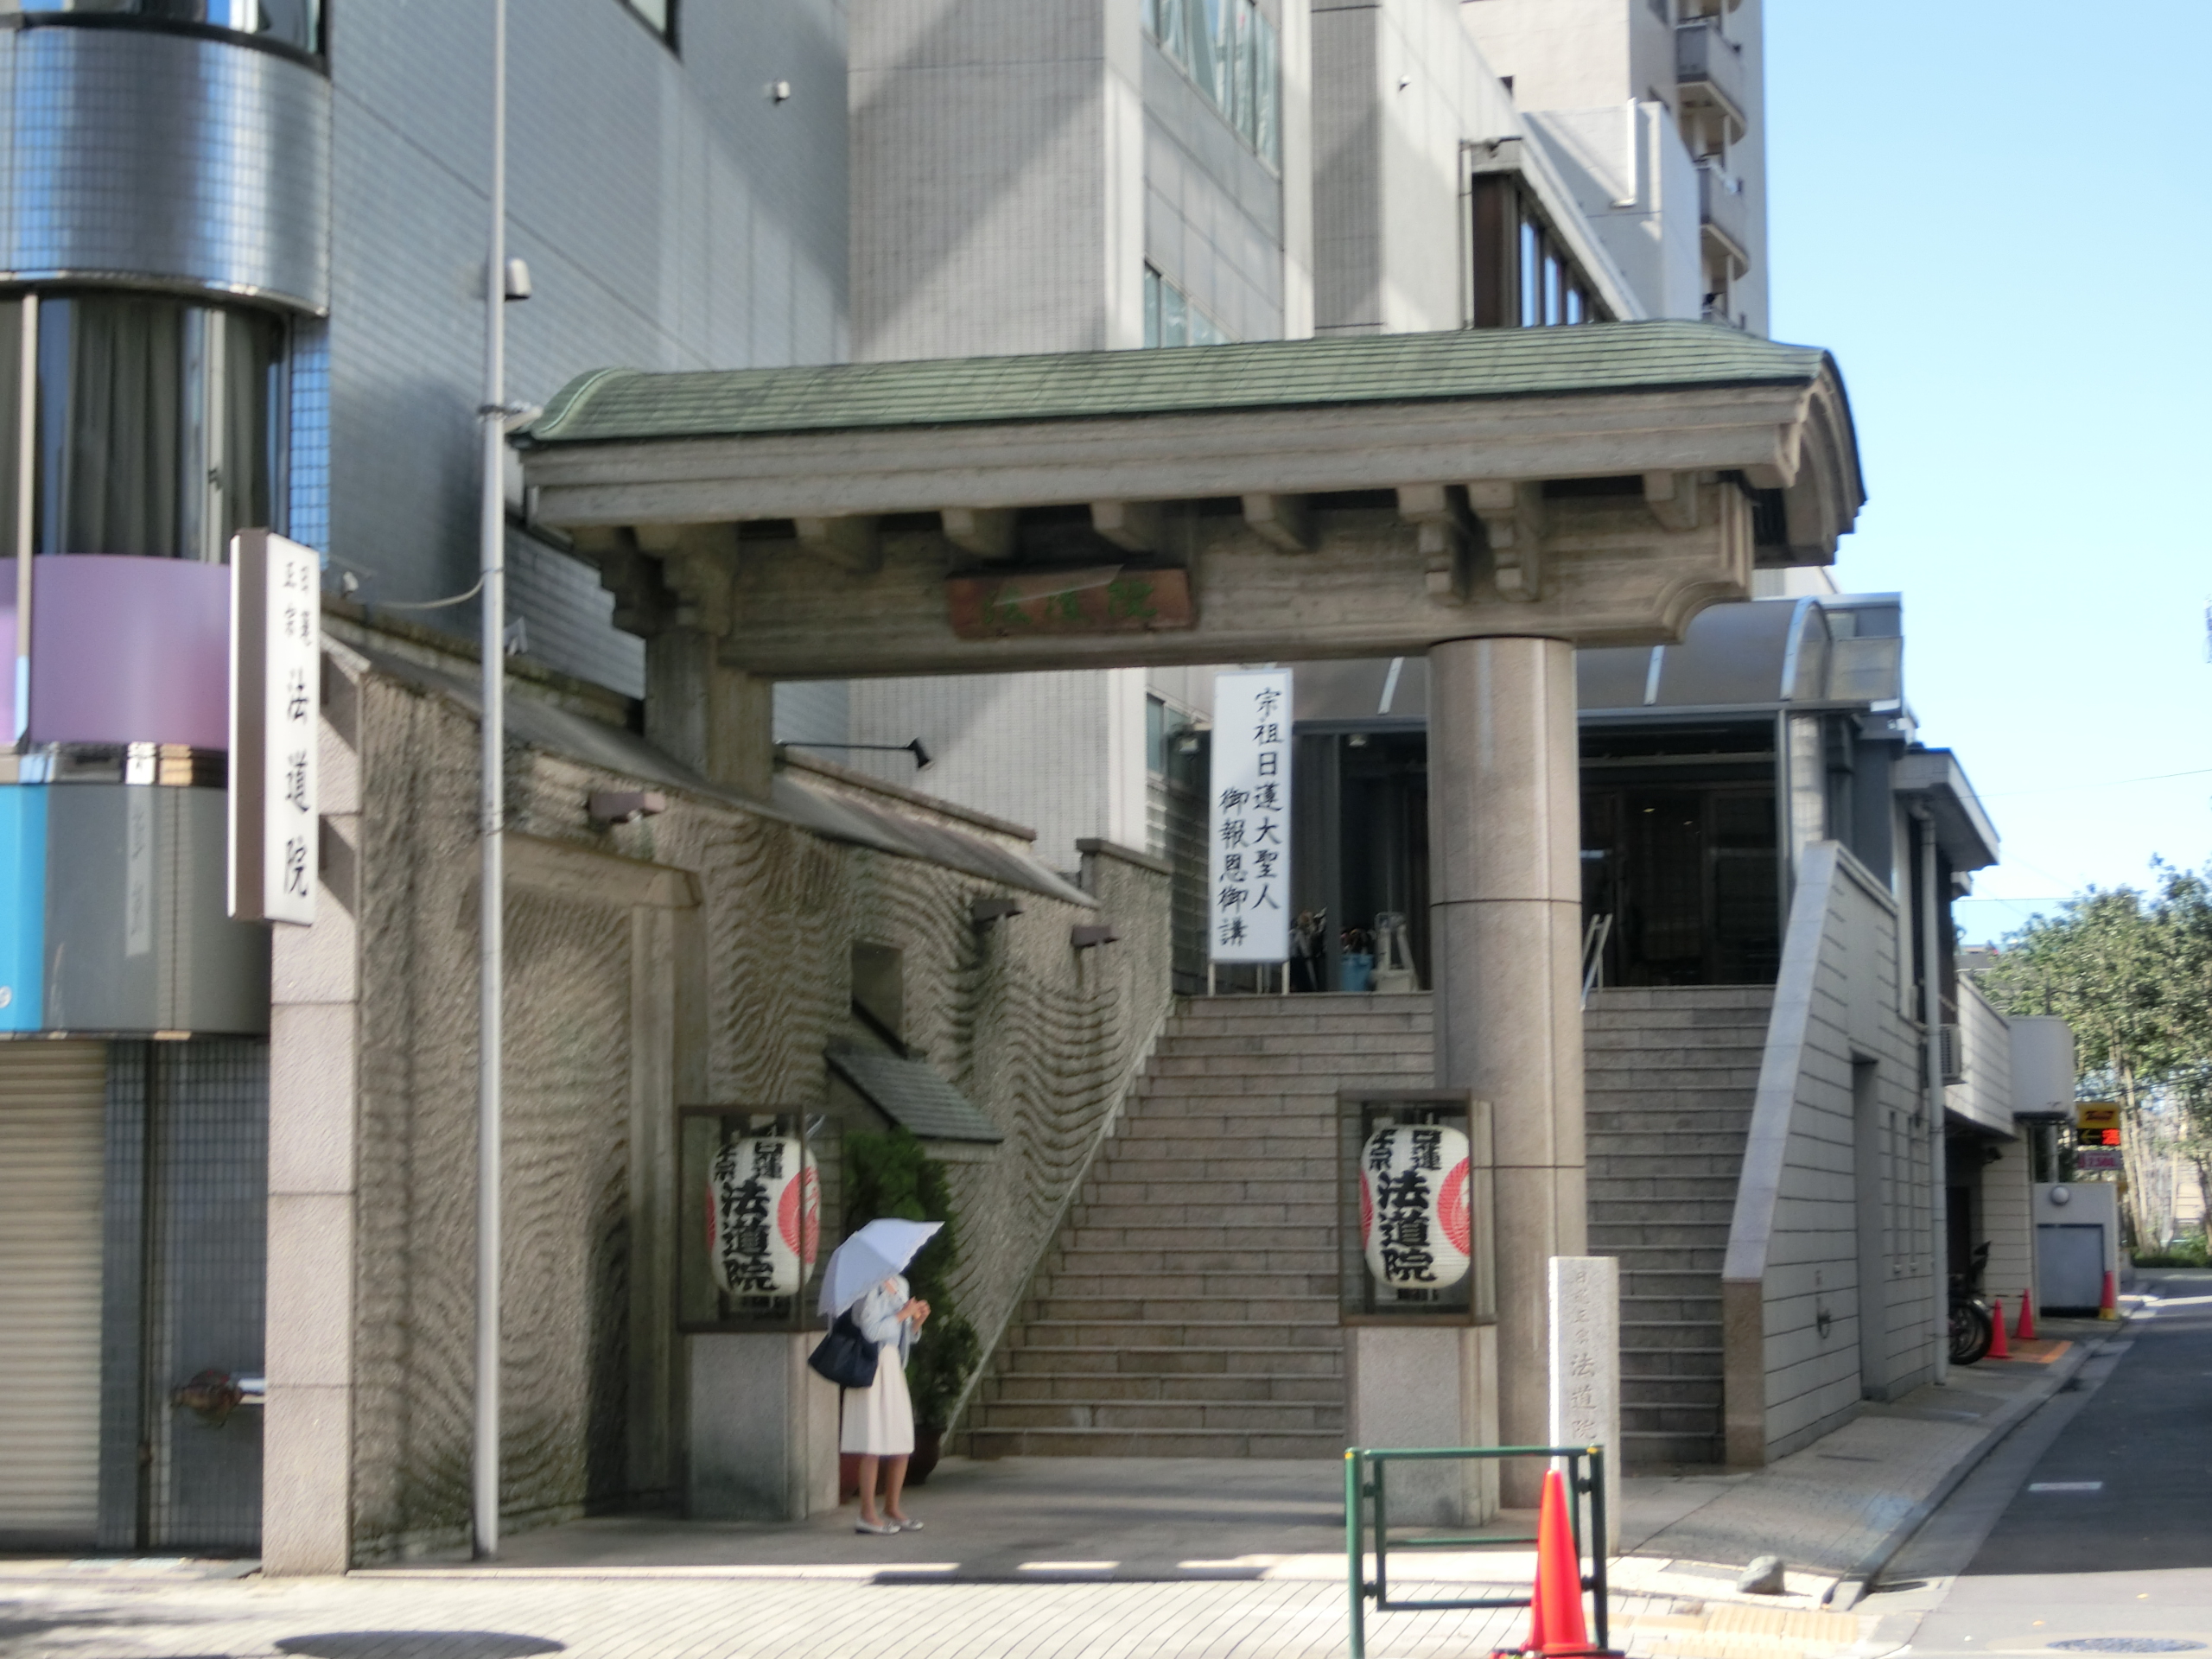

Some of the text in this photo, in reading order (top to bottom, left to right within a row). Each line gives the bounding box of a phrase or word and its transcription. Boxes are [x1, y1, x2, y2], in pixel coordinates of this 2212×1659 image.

[1217, 786, 1249, 947] 御報恩御講
[1252, 686, 1283, 911] 宗祖日蓮大聖人
[721, 1176, 780, 1292] 法道院
[1377, 1169, 1437, 1283] 法道院
